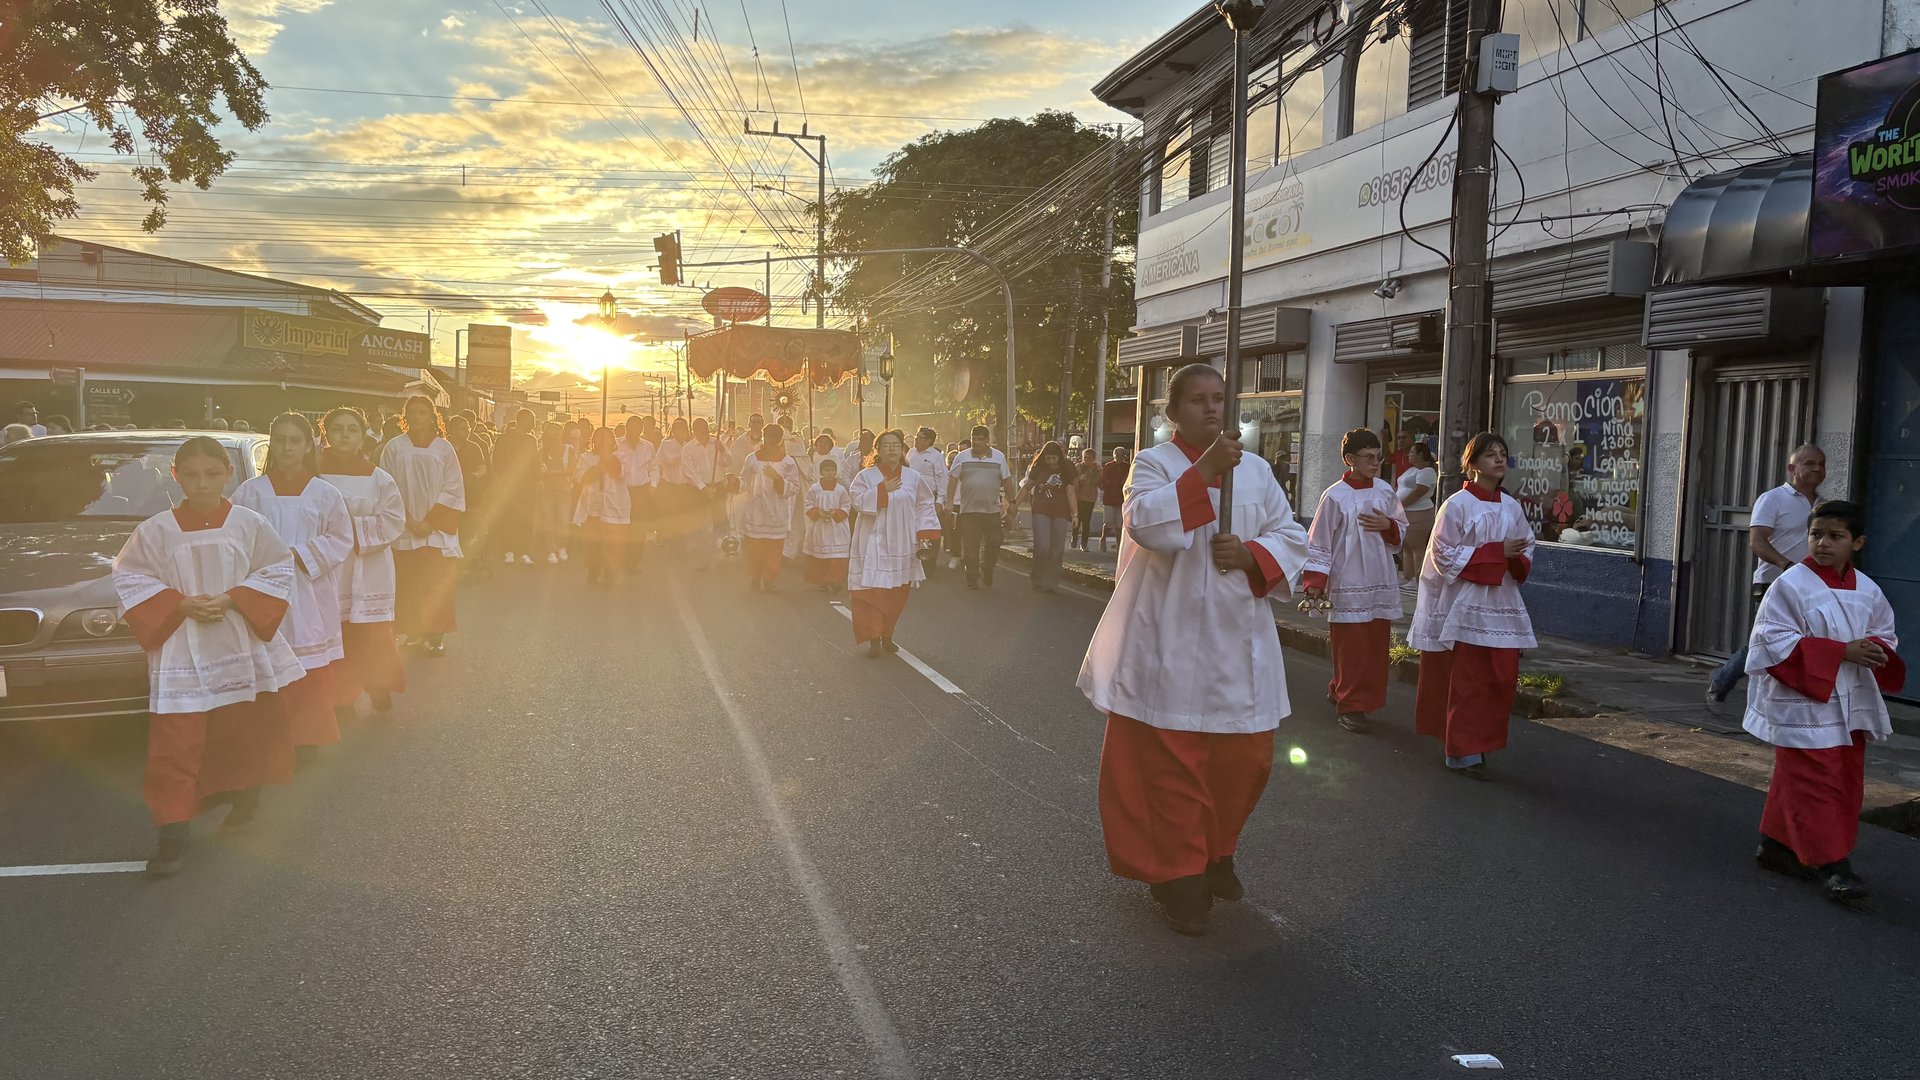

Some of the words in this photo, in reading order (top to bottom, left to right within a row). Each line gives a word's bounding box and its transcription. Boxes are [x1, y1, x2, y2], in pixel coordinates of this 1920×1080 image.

[1878, 127, 1900, 143] THE
[1850, 137, 1920, 176] WORL
[1141, 249, 1200, 288] AMERICANA
[282, 320, 351, 351] Imperial
[361, 333, 424, 354] ANCASH
[368, 348, 416, 361] RESTAURANTE
[1542, 426, 1551, 447] 2
[1572, 422, 1585, 443] 1
[1600, 436, 1635, 450] 1300
[1519, 477, 1550, 497] 2900
[1590, 523, 1629, 541] 3500
